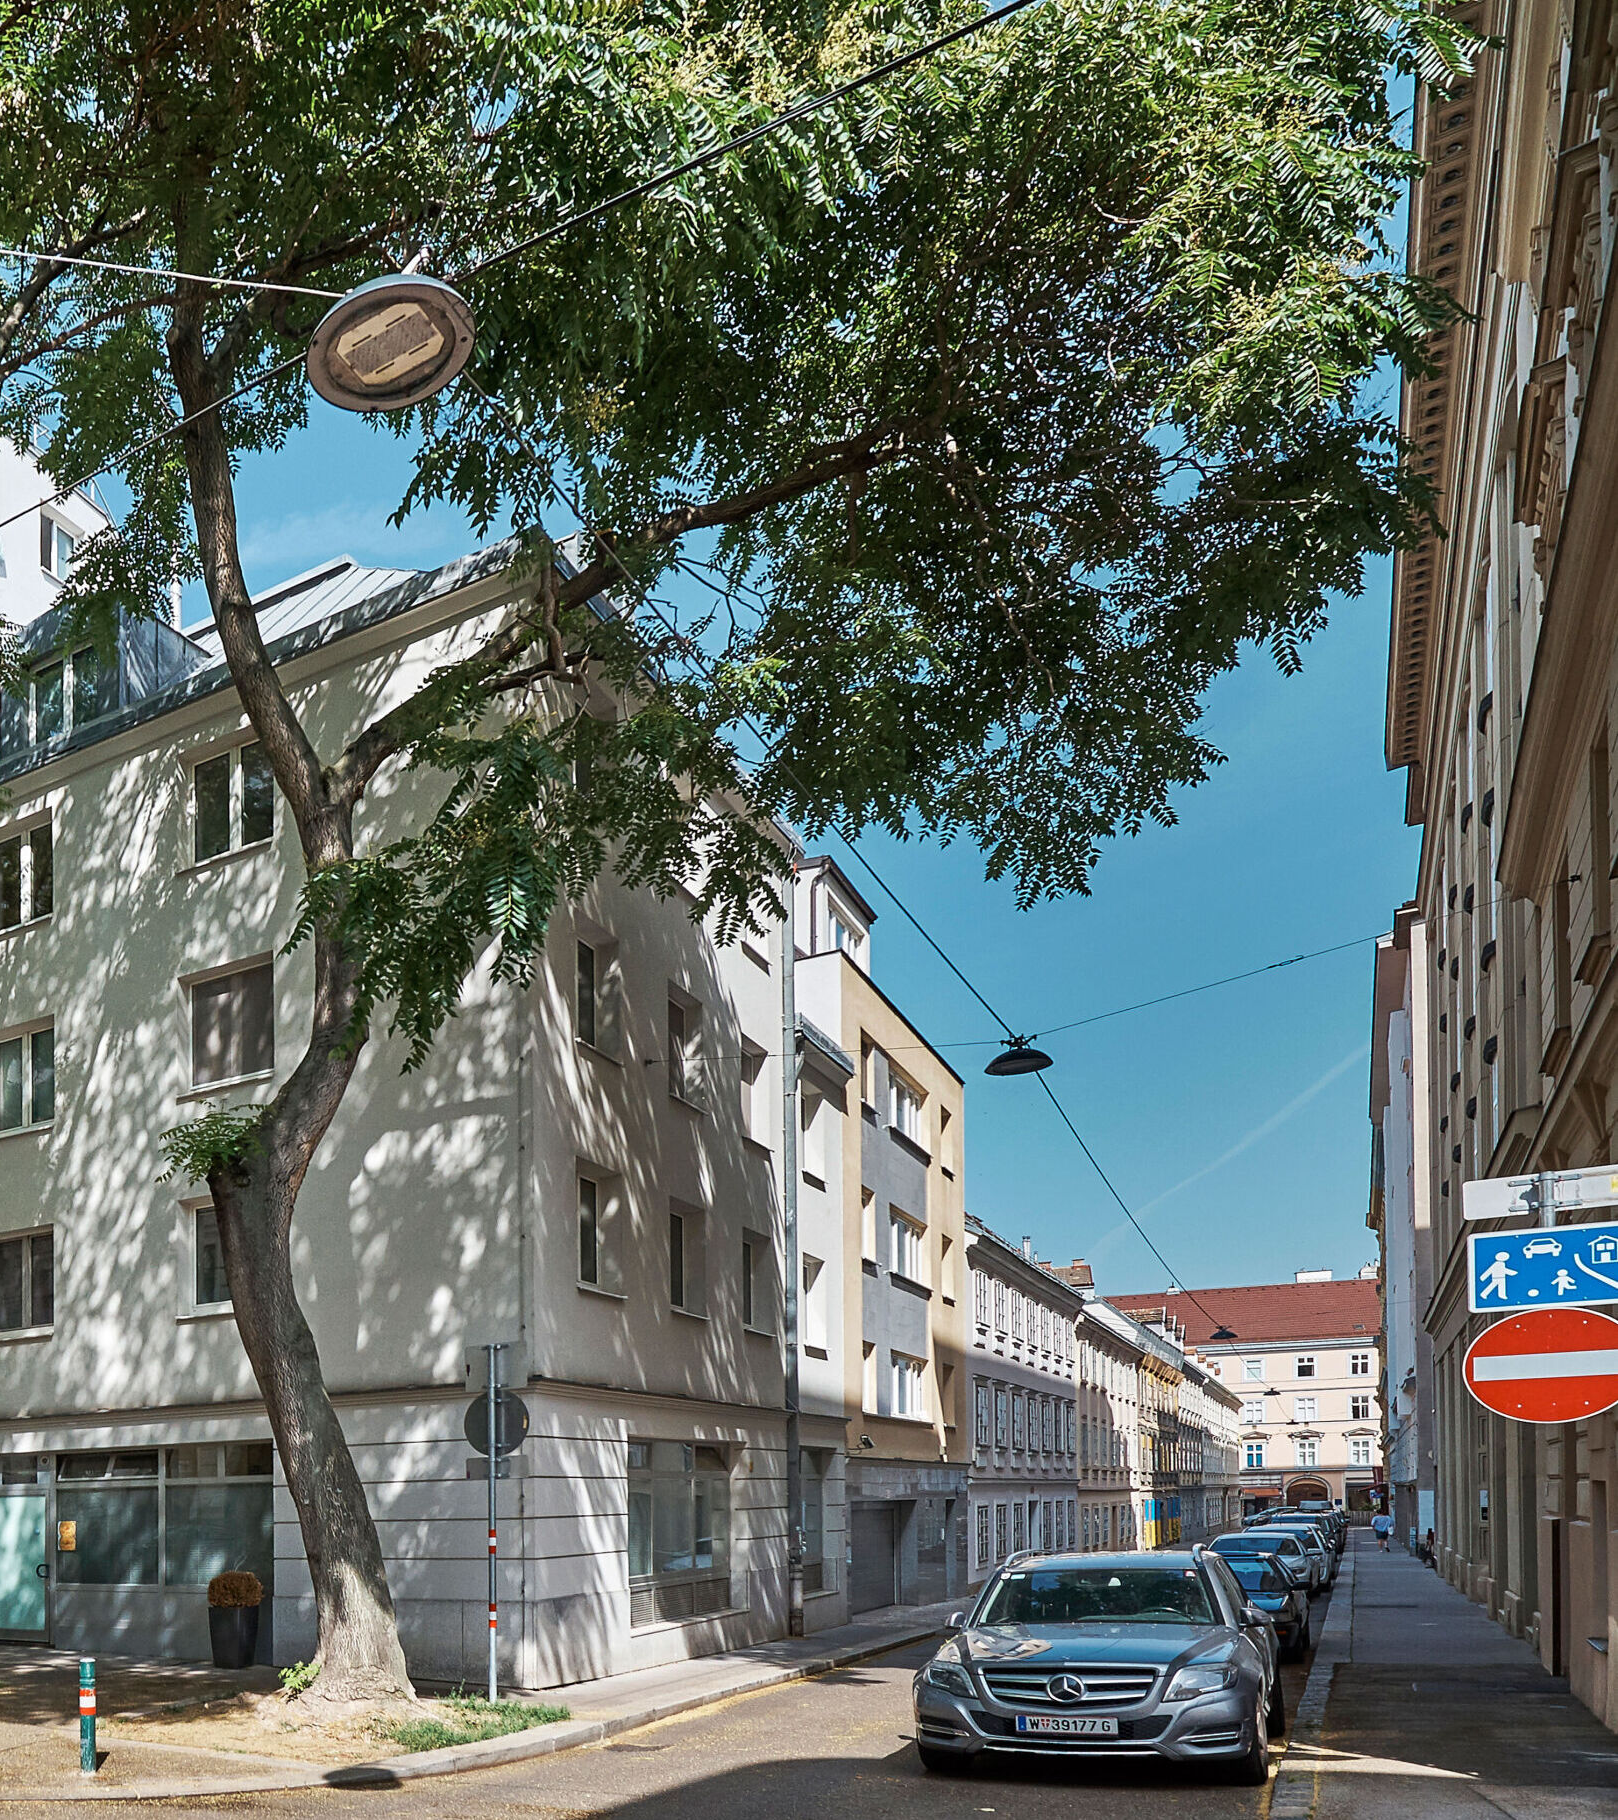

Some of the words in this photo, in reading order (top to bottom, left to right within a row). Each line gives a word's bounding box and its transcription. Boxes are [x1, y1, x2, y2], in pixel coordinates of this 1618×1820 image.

[1029, 1719, 1039, 1730] W
[1051, 1719, 1097, 1731] 39177
[1101, 1720, 1111, 1732] G
